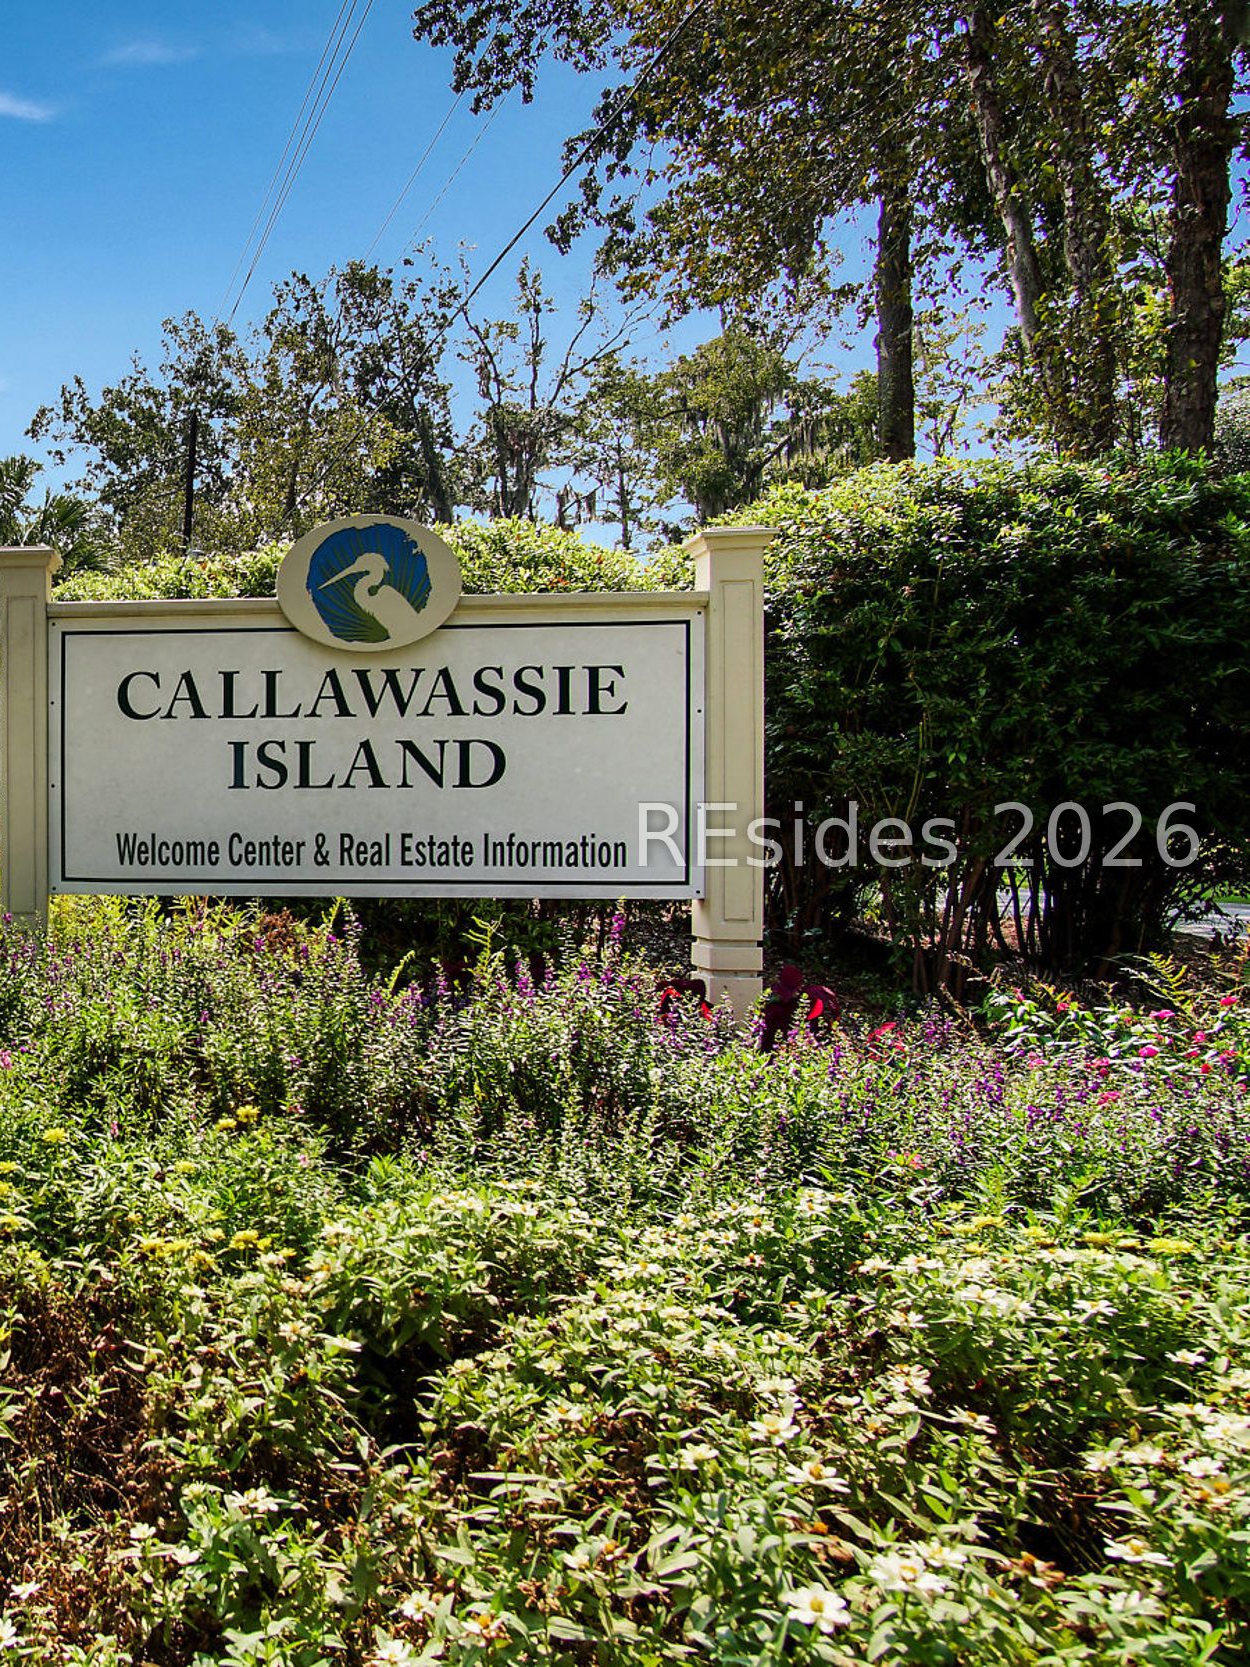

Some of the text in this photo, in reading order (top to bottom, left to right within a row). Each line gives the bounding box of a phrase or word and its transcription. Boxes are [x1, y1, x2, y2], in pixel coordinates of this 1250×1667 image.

[117, 665, 628, 720] CALLAWASSIE
[228, 739, 507, 790] ISLAND
[116, 832, 627, 868] Welcome Center & Real Estate Information
